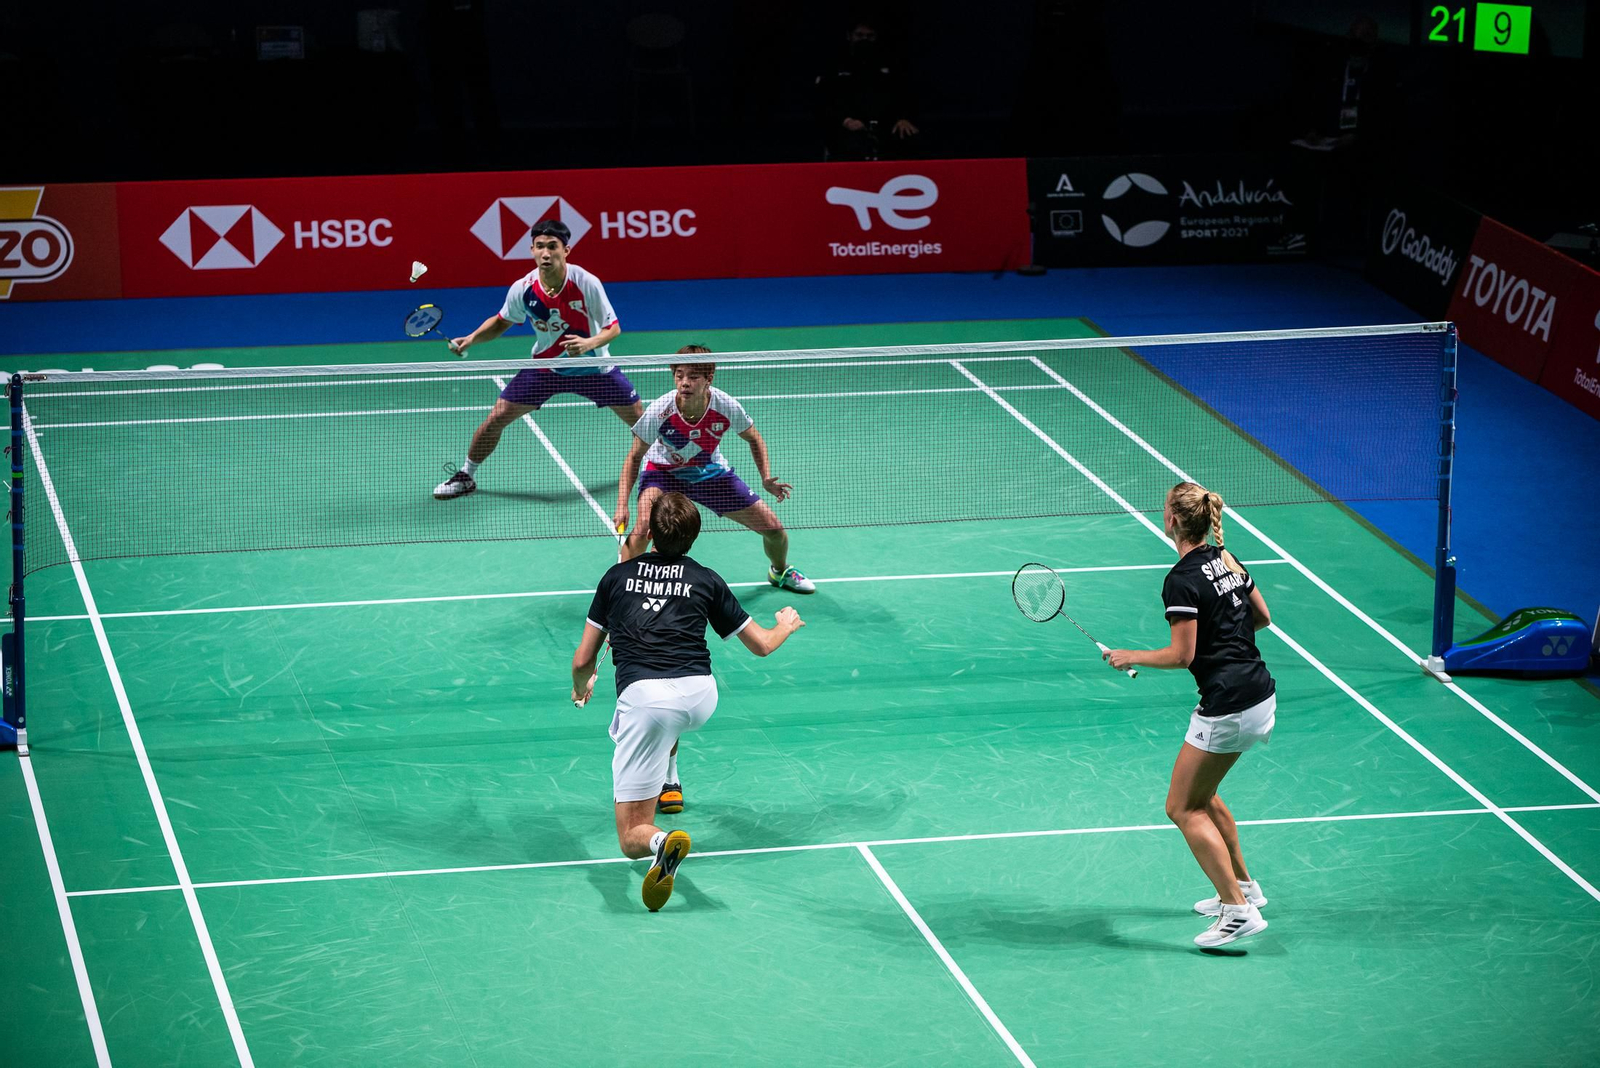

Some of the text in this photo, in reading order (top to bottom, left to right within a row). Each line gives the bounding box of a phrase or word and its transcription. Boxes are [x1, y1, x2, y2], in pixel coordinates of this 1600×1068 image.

[1428, 5, 1466, 43] 21
[1493, 11, 1512, 46] 9
[294, 218, 393, 249] HSBC
[600, 208, 697, 239] HSBC
[1180, 213, 1284, 227] European Region of
[1180, 228, 1249, 239] SPORT 2021
[829, 240, 942, 258] TotalEnergies
[1401, 227, 1458, 286] GoDaddy
[1462, 253, 1557, 342] TOYOTA
[637, 561, 685, 579] THYRRI
[625, 578, 693, 598] DENMARK
